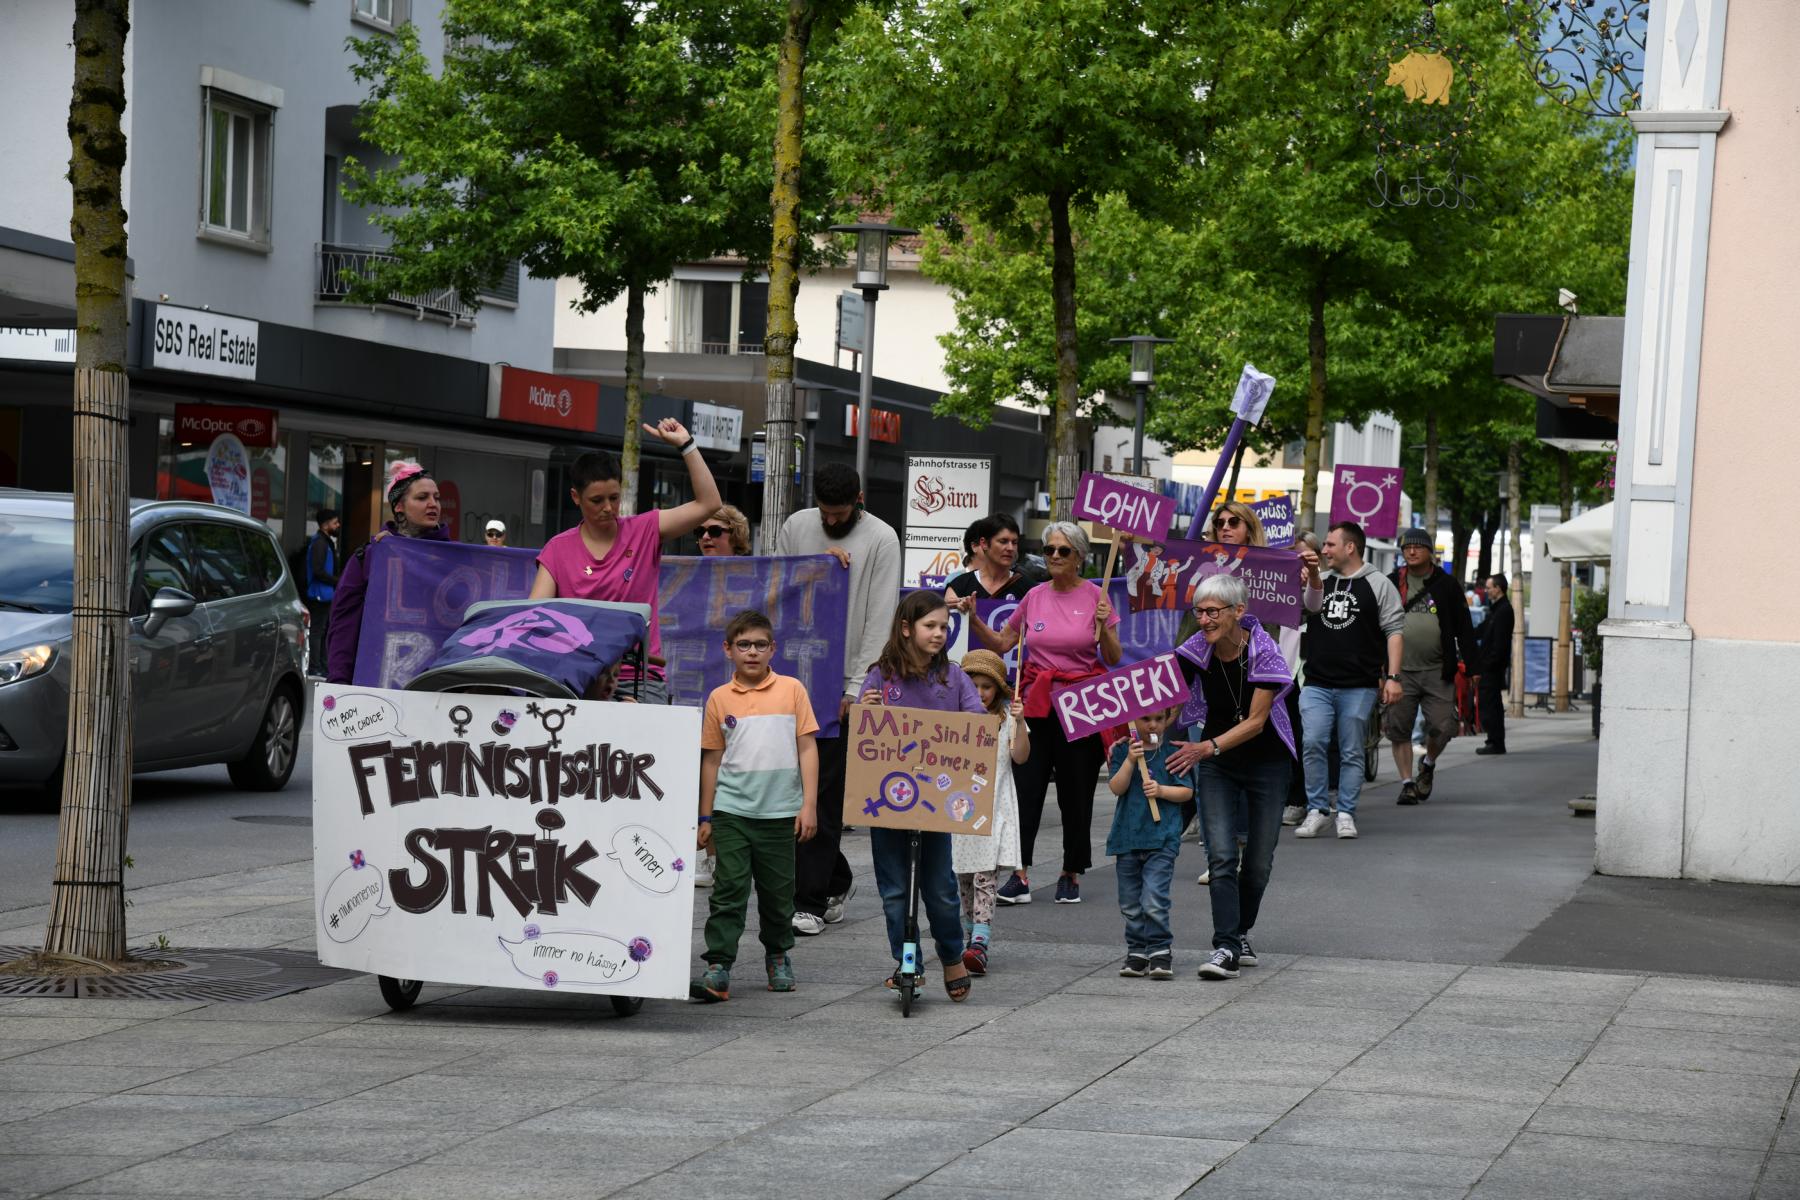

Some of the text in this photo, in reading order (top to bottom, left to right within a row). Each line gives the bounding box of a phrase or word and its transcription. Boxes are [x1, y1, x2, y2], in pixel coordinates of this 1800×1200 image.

[155, 318, 256, 367] SBS Real Estate
[181, 417, 233, 432] McOptic
[908, 458, 990, 470] Bahnhofstrasse 15
[910, 475, 979, 516] Bären
[1083, 479, 1161, 533] LOHN
[1253, 500, 1287, 521] CHÜSS
[1264, 521, 1295, 540] ARCHAT
[1240, 567, 1288, 583] 14. JUNI
[1247, 579, 1276, 592] JUIN
[1058, 653, 1180, 734] RESPEKT
[327, 707, 358, 729] MY BODY
[857, 709, 923, 737] Mir
[976, 725, 997, 747] für
[343, 724, 357, 737] MY
[857, 738, 907, 762] Girl
[533, 942, 567, 958] immer
[571, 951, 584, 962] no
